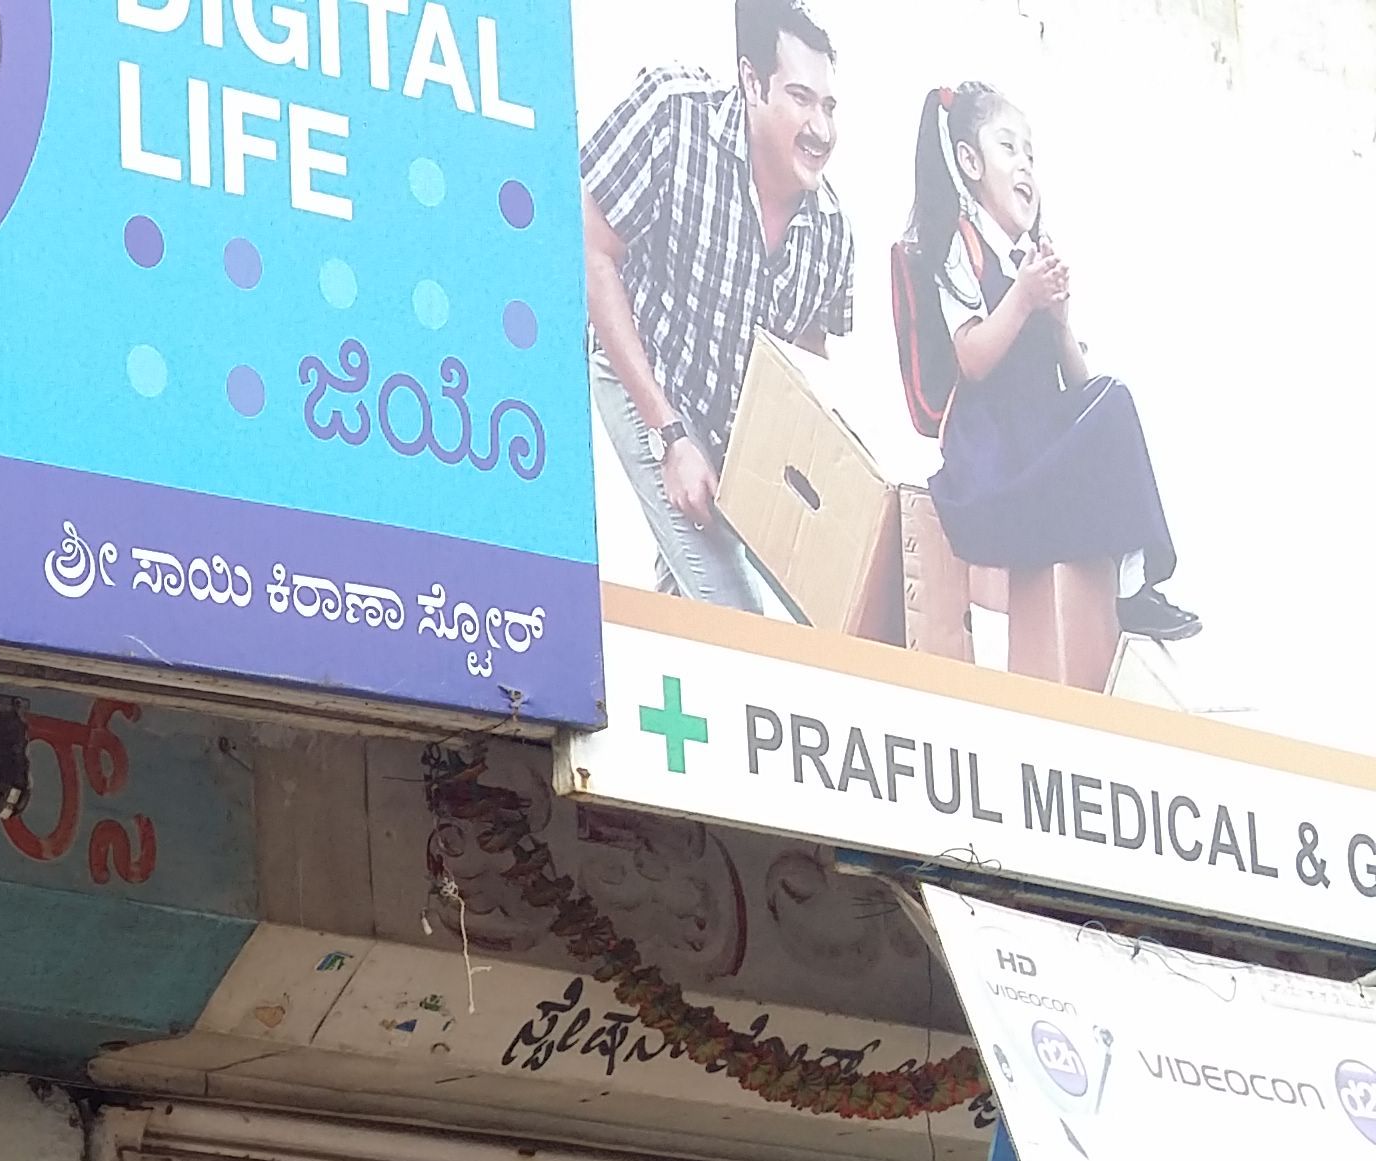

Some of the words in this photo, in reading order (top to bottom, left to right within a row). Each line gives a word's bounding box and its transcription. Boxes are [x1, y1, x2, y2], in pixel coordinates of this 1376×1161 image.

[119, 61, 354, 221] LIFE
[44, 520, 119, 599] ಶ್ರೀ
[131, 545, 253, 611] ಸಾಯಿ
[266, 562, 405, 633] ಕಿರಾಣಾ
[745, 704, 1004, 824] PRAFUL
[1021, 762, 1279, 878] MEDICAL
[1295, 821, 1330, 890] &
[996, 948, 1037, 977] HD
